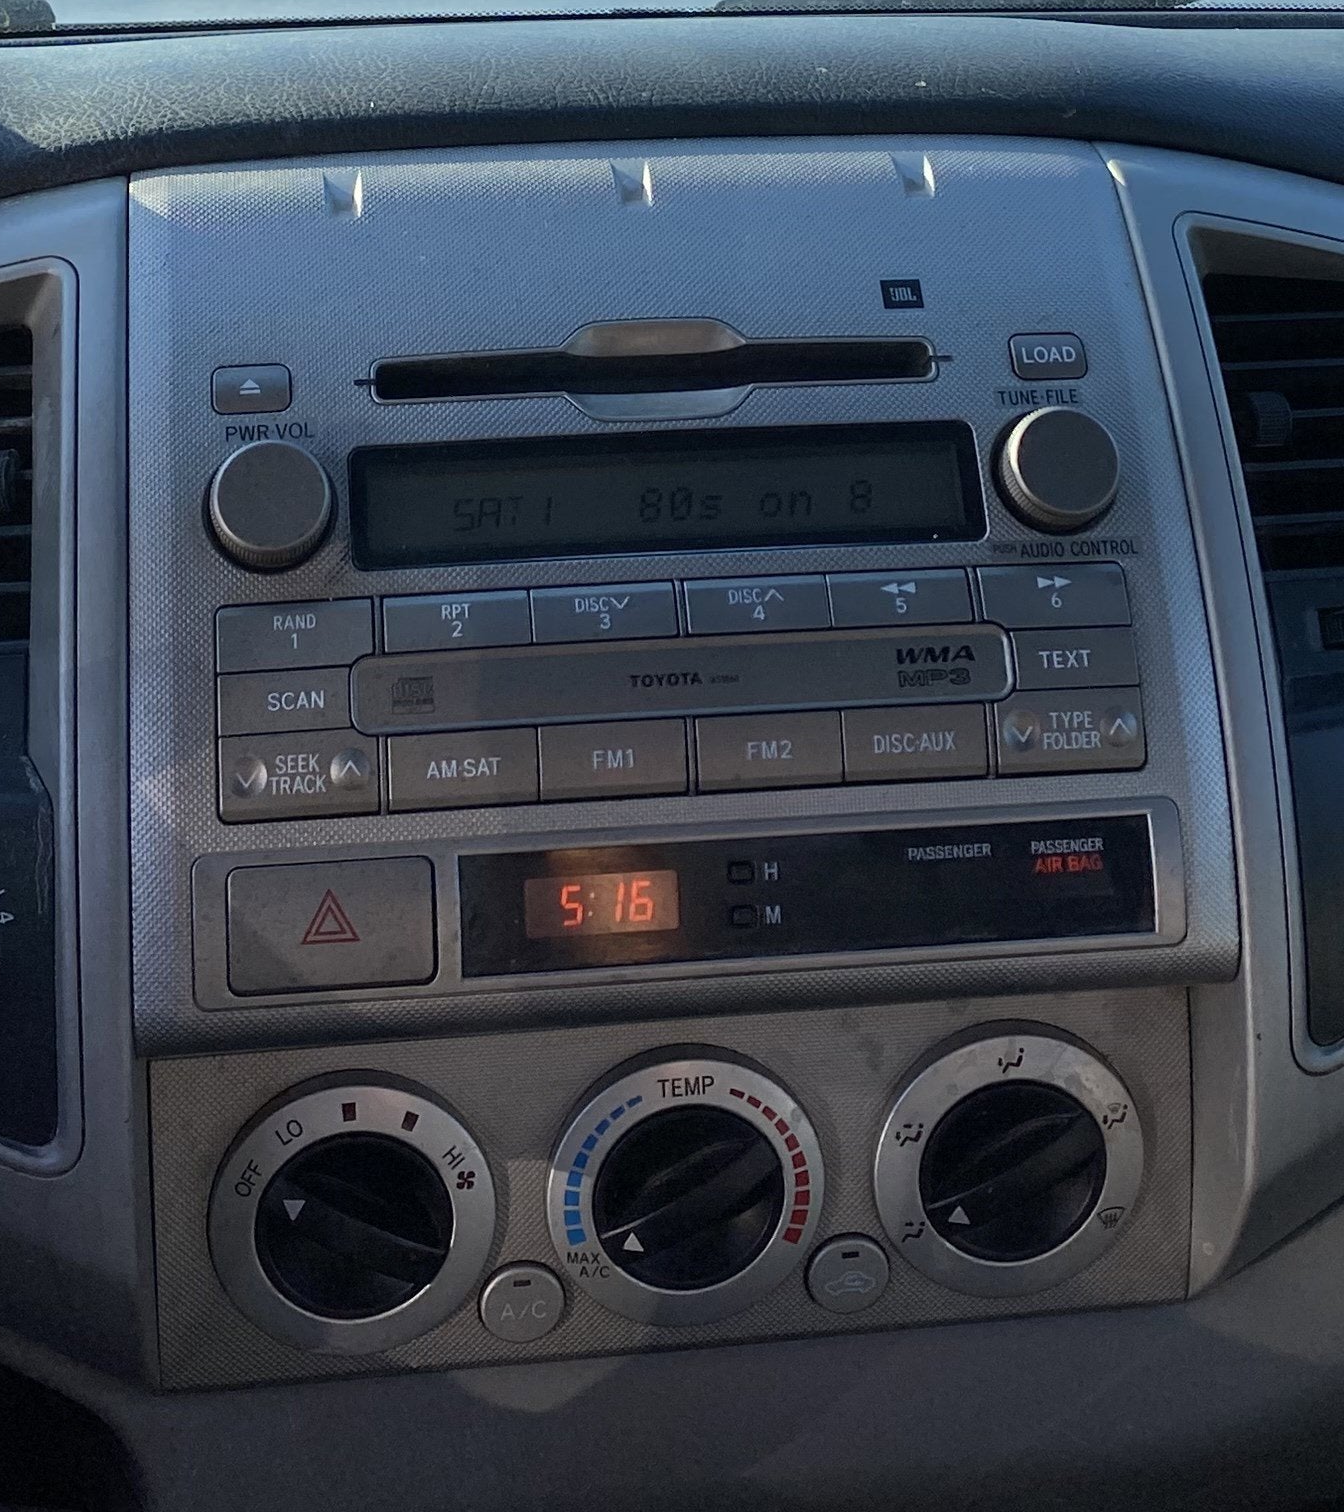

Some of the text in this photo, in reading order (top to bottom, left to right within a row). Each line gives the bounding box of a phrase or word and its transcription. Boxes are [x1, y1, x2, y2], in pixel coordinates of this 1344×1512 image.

[1021, 346, 1077, 365] LOAD
[759, 488, 813, 517] on
[850, 479, 873, 514] 8
[1020, 540, 1066, 558] AUDIO
[1070, 538, 1139, 557] CONTROL
[574, 595, 610, 614] DISC
[727, 587, 763, 606] DISC
[895, 597, 908, 615] 5
[1051, 592, 1063, 609] 6
[273, 613, 316, 631] RAND
[441, 603, 472, 621] RPT
[599, 612, 612, 630] 3
[752, 604, 766, 621] 4
[451, 621, 464, 638] 2
[290, 634, 298, 649] 1
[894, 644, 977, 666] WMA
[1038, 648, 1093, 670] TEXT
[629, 671, 703, 689] TOYOTA
[897, 667, 973, 689] MP3
[266, 691, 325, 712] SCAN
[1049, 710, 1095, 730] TYPE
[746, 739, 794, 761] FM2
[1042, 731, 1102, 751] FOLDER
[274, 753, 321, 774] SEEK
[592, 748, 635, 770] FM1
[268, 774, 327, 796] TRACK
[907, 841, 993, 861] PASSENGER
[1030, 836, 1105, 855] PASSENGER
[763, 861, 780, 881] H
[1032, 853, 1104, 874] AIR BAG
[559, 879, 655, 928] 5:16
[765, 905, 782, 925] M
[656, 1075, 716, 1100] TEMP
[274, 1119, 305, 1147] LO
[441, 1145, 467, 1170] HI
[234, 1161, 264, 1199] OFF
[566, 1250, 602, 1266] MAX
[578, 1263, 611, 1280] A/C
[500, 1298, 548, 1322] A/C
